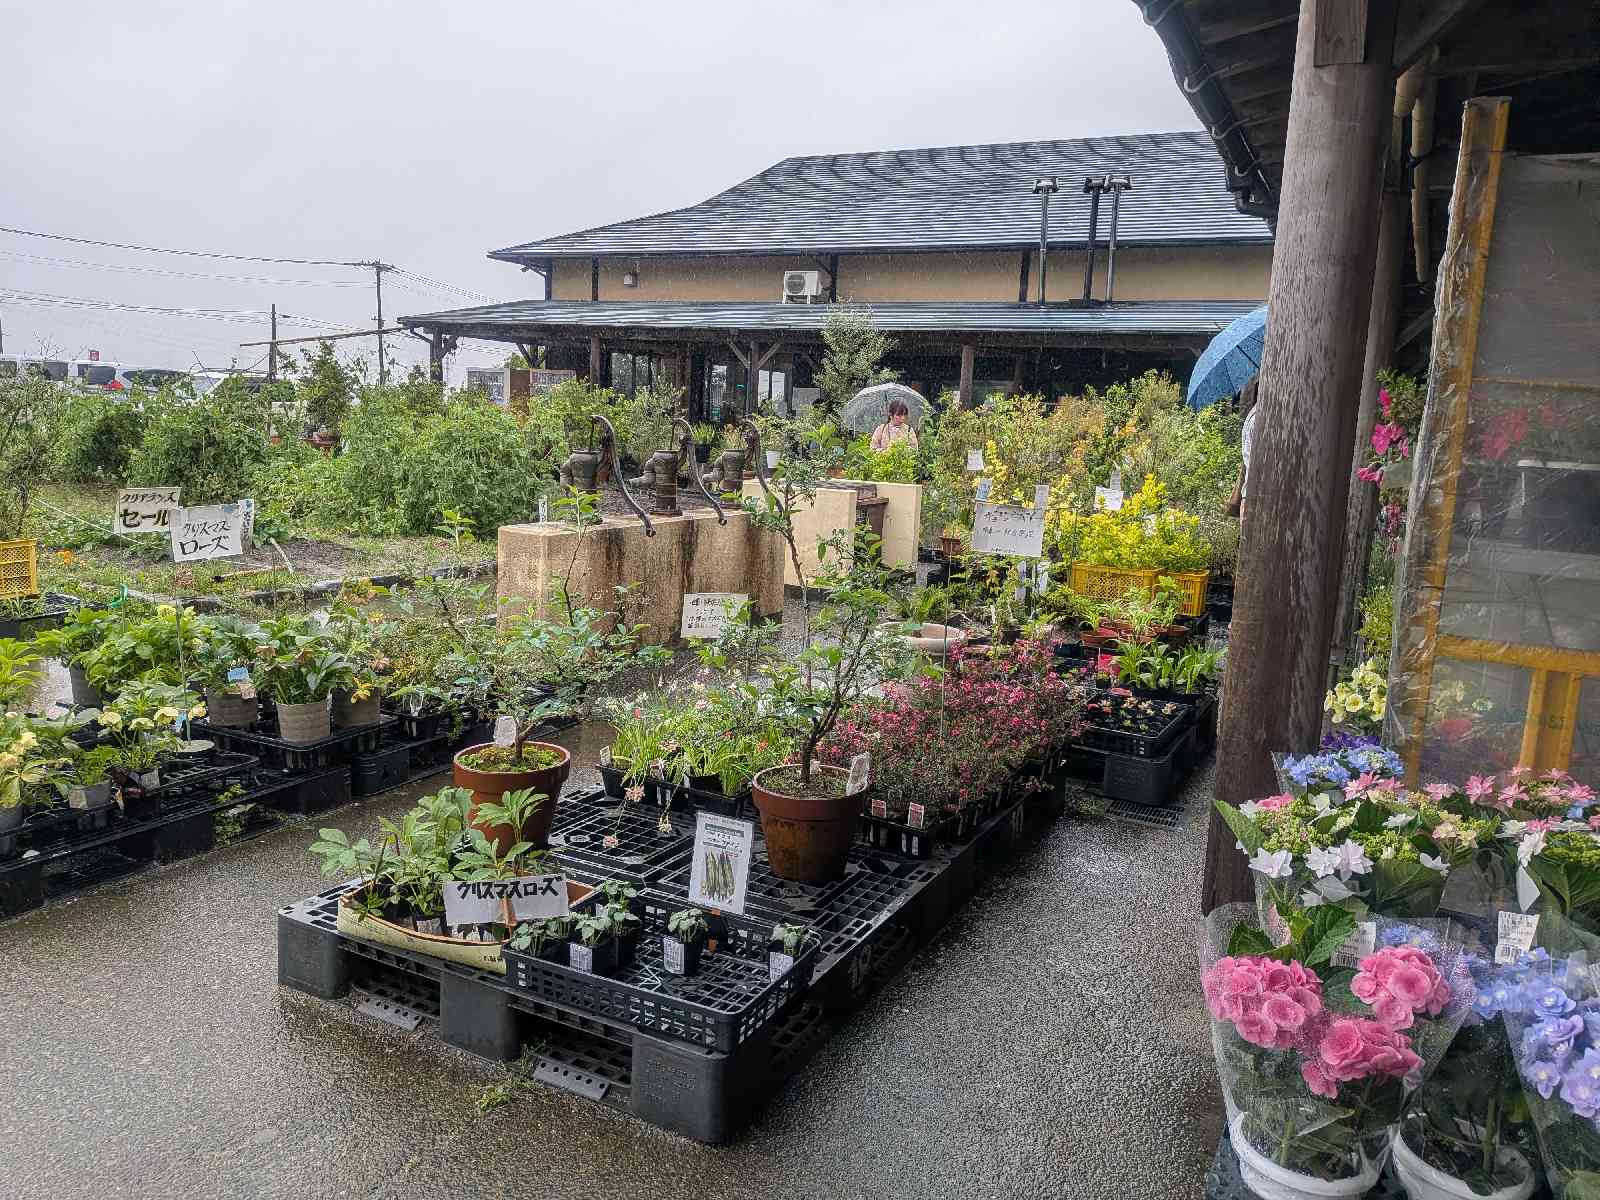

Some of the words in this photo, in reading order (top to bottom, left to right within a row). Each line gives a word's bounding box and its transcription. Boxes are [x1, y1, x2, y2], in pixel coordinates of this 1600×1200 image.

[120, 509, 169, 528] セール
[184, 520, 231, 537] クリスマス
[179, 535, 230, 556] ローズ
[457, 876, 562, 899] クリスマスローズ
